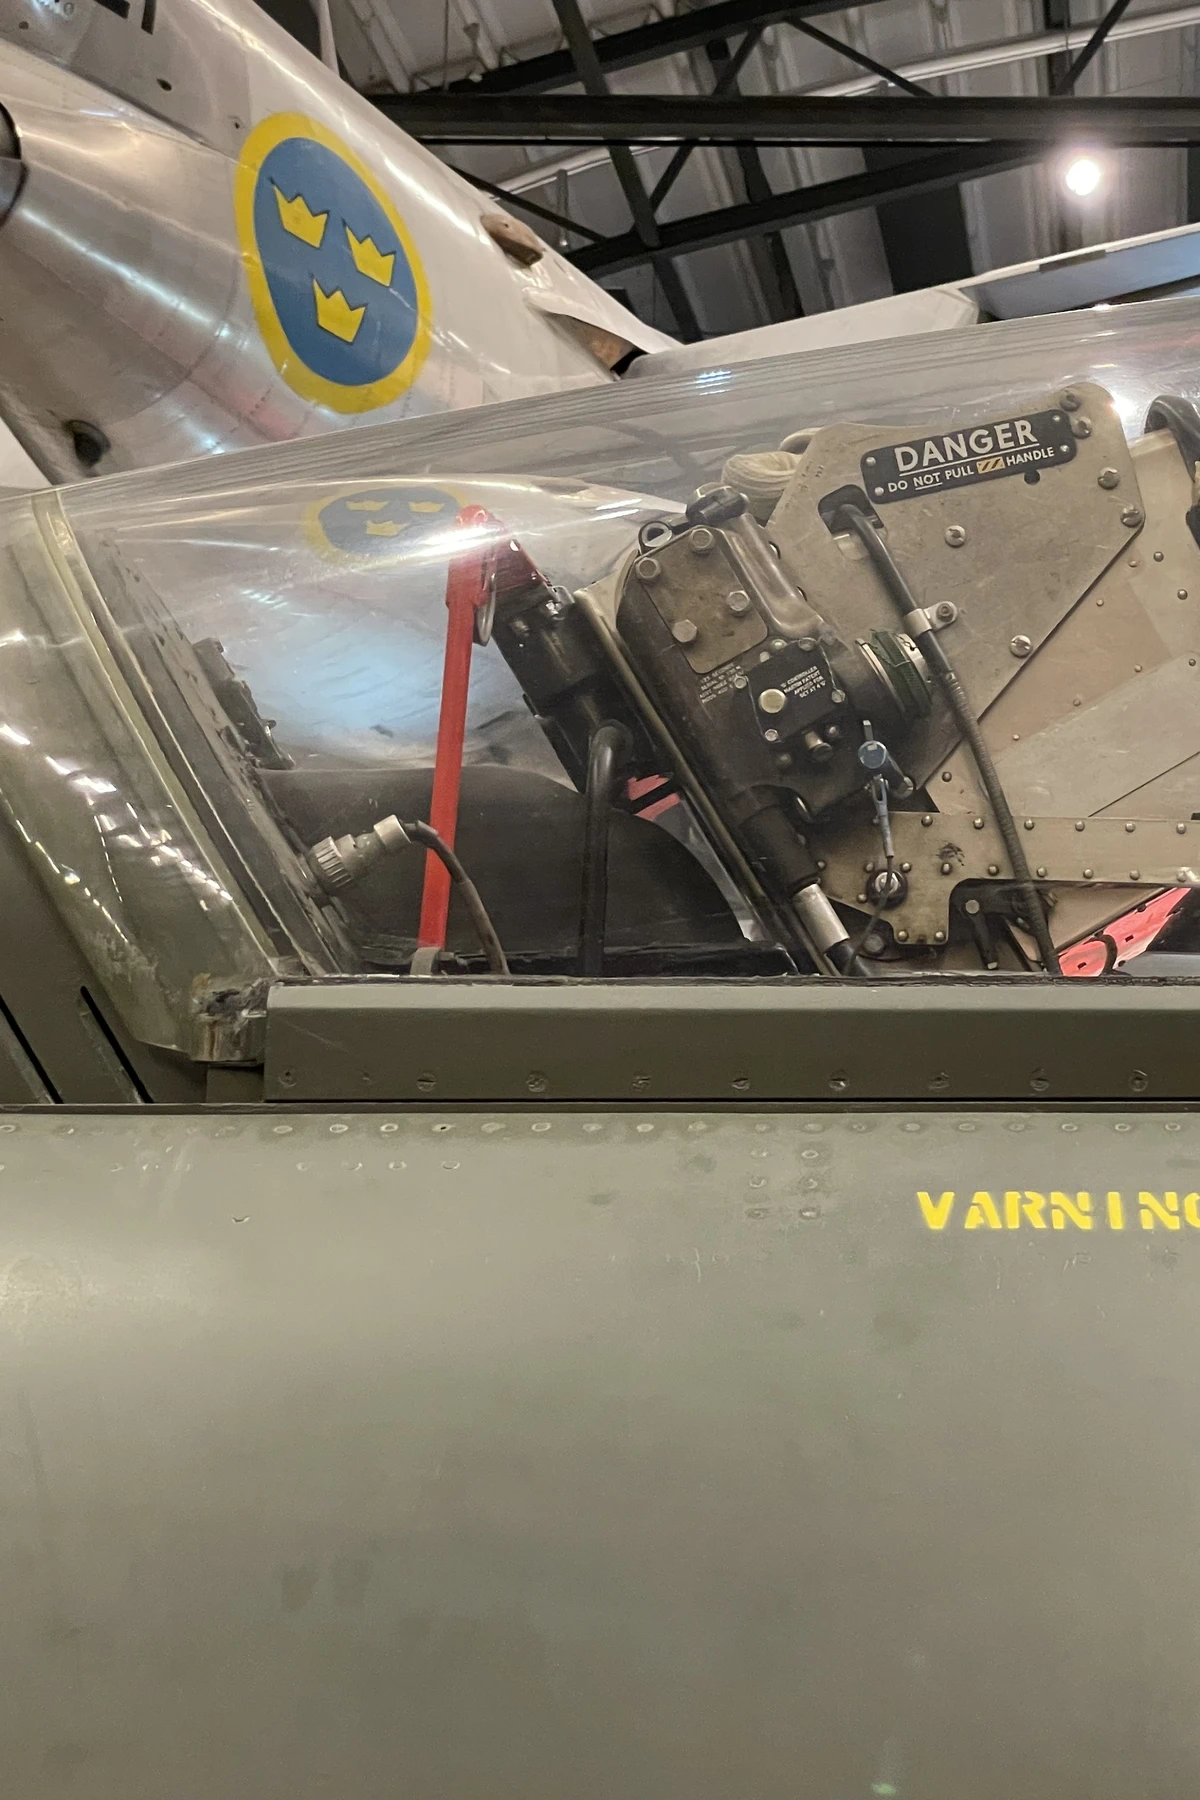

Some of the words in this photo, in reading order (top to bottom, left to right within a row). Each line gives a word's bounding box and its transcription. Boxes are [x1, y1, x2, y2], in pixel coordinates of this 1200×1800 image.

[887, 480, 908, 493] DO
[913, 472, 942, 488] NOT
[945, 465, 975, 480] PULL
[1006, 447, 1055, 466] HANDLE
[893, 419, 1038, 472] DANGER
